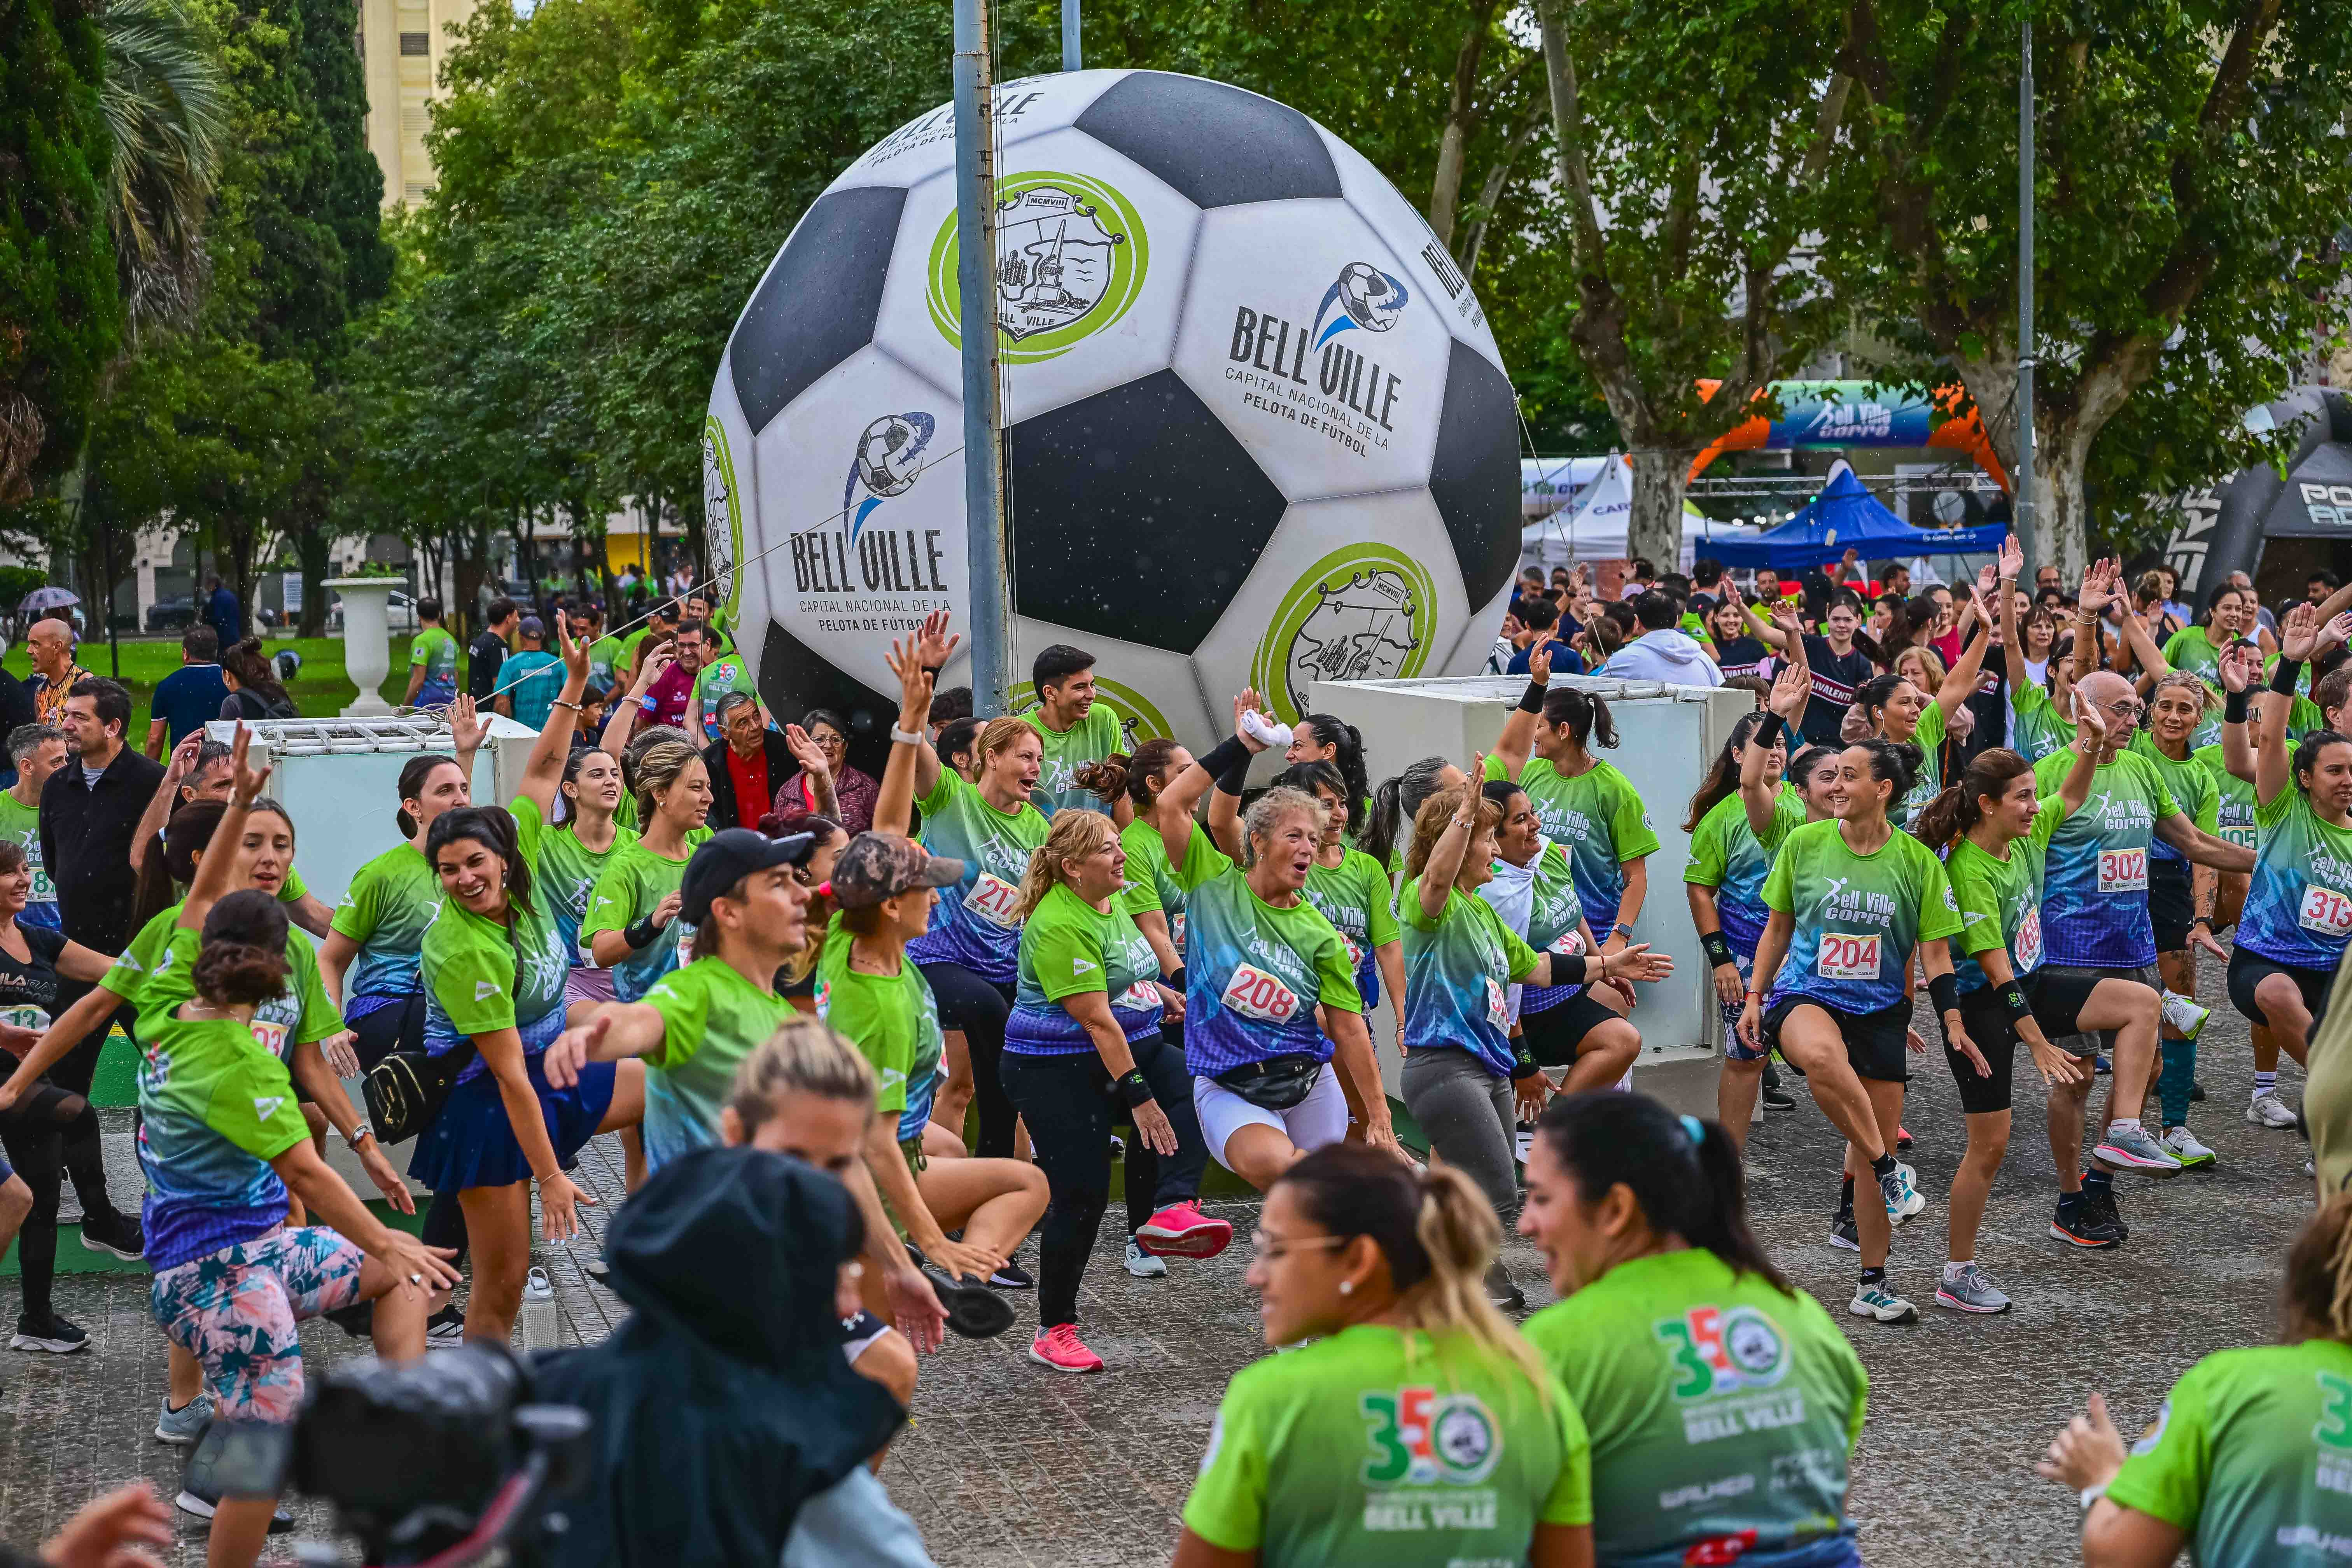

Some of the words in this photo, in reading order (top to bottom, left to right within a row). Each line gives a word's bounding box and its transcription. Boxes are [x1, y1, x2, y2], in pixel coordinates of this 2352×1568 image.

[872, 142, 915, 168] PELOTA
[920, 136, 937, 145] DE
[1030, 197, 1065, 206] MCMVIII
[1026, 315, 1055, 327] VILLE
[1229, 305, 1309, 386] BELL
[1319, 341, 1402, 432] VILLE
[1225, 366, 1283, 397] CAPITAL
[1288, 389, 1354, 430] NACIONAL
[1356, 421, 1373, 439] DE
[1374, 432, 1389, 451] LA
[1243, 391, 1296, 421] PELOTA
[1300, 412, 1318, 430] DE
[1321, 422, 1367, 458] FÚTBOL
[790, 532, 855, 593] BELL
[858, 529, 948, 594] VILLE
[1377, 582, 1401, 599] MCMVIII
[800, 600, 843, 613] CAPITAL
[846, 600, 908, 613] NACIONAL
[912, 599, 929, 612] DE
[933, 599, 951, 612] LA
[819, 619, 860, 632] PELOTA
[863, 619, 878, 631] DE
[881, 615, 926, 631] FÚTBO
[671, 713, 685, 723] PU
[1566, 809, 1590, 831] Ville
[2104, 817, 2151, 830] corre
[2127, 800, 2150, 818] Ville
[1537, 821, 1587, 840] corre
[2102, 852, 2145, 882] 302
[1340, 906, 1366, 927] Ville
[1825, 906, 1892, 928] corre
[1866, 891, 1897, 915] Ville
[2308, 891, 2352, 928] 313
[2016, 913, 2039, 962] 269
[1822, 937, 1878, 968] 204
[1229, 970, 1295, 1017] 208
[1654, 1306, 1794, 1401] 350
[1683, 1408, 1744, 1445] BELL
[1747, 1397, 1806, 1431] VILLE
[1360, 1384, 1503, 1489] 350
[1363, 1502, 1427, 1531] BELL
[1431, 1502, 1498, 1530] VILLE
